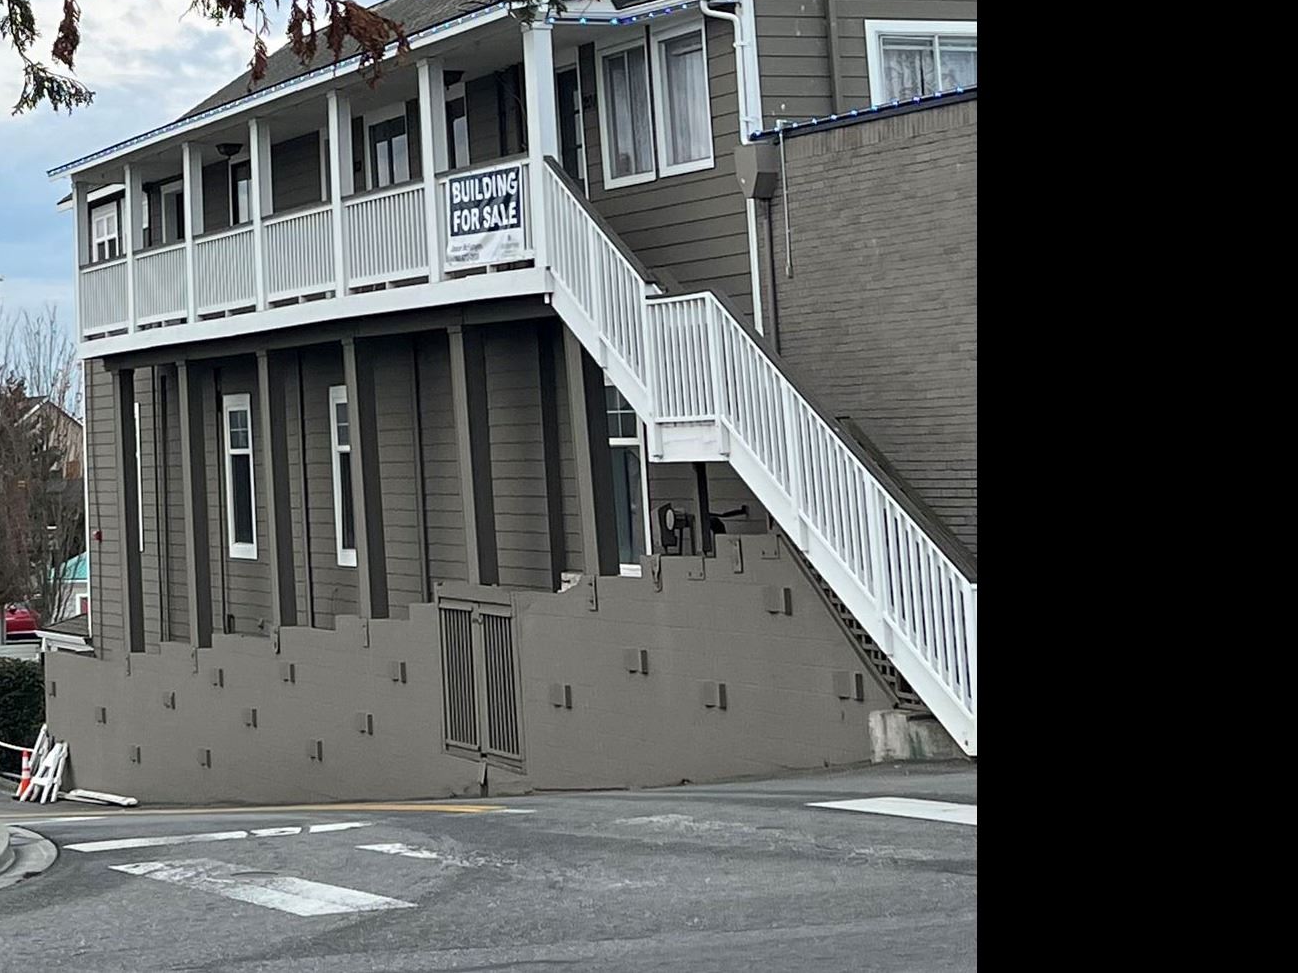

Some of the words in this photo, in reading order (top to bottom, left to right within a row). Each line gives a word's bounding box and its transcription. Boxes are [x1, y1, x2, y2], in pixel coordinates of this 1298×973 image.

[452, 172, 518, 204] BUILDING
[453, 208, 481, 233] FOR
[483, 202, 518, 229] SALE
